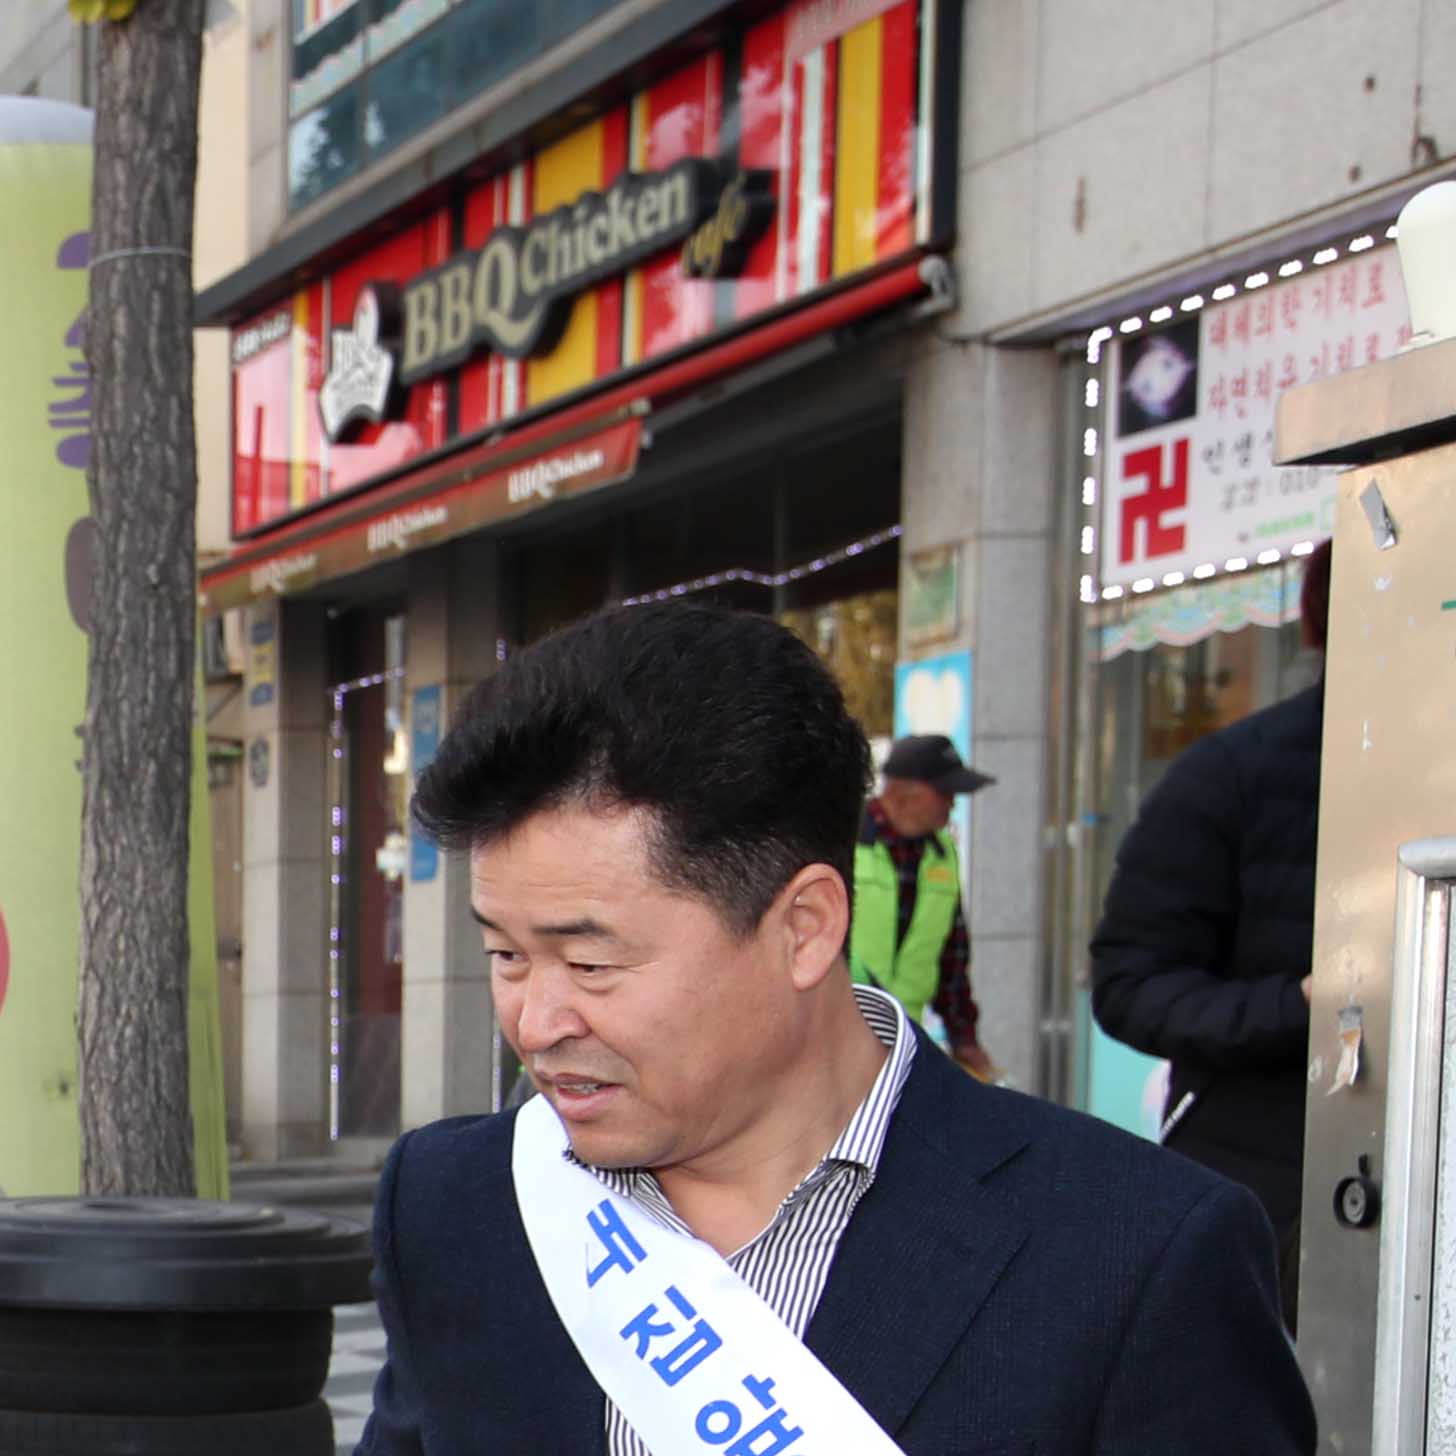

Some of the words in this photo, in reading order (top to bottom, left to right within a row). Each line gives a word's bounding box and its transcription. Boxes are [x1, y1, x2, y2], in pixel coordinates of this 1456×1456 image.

[402, 237, 545, 373] BBQ
[521, 171, 688, 297] Chicken
[585, 1199, 648, 1288] 내
[620, 1286, 722, 1387] 집
